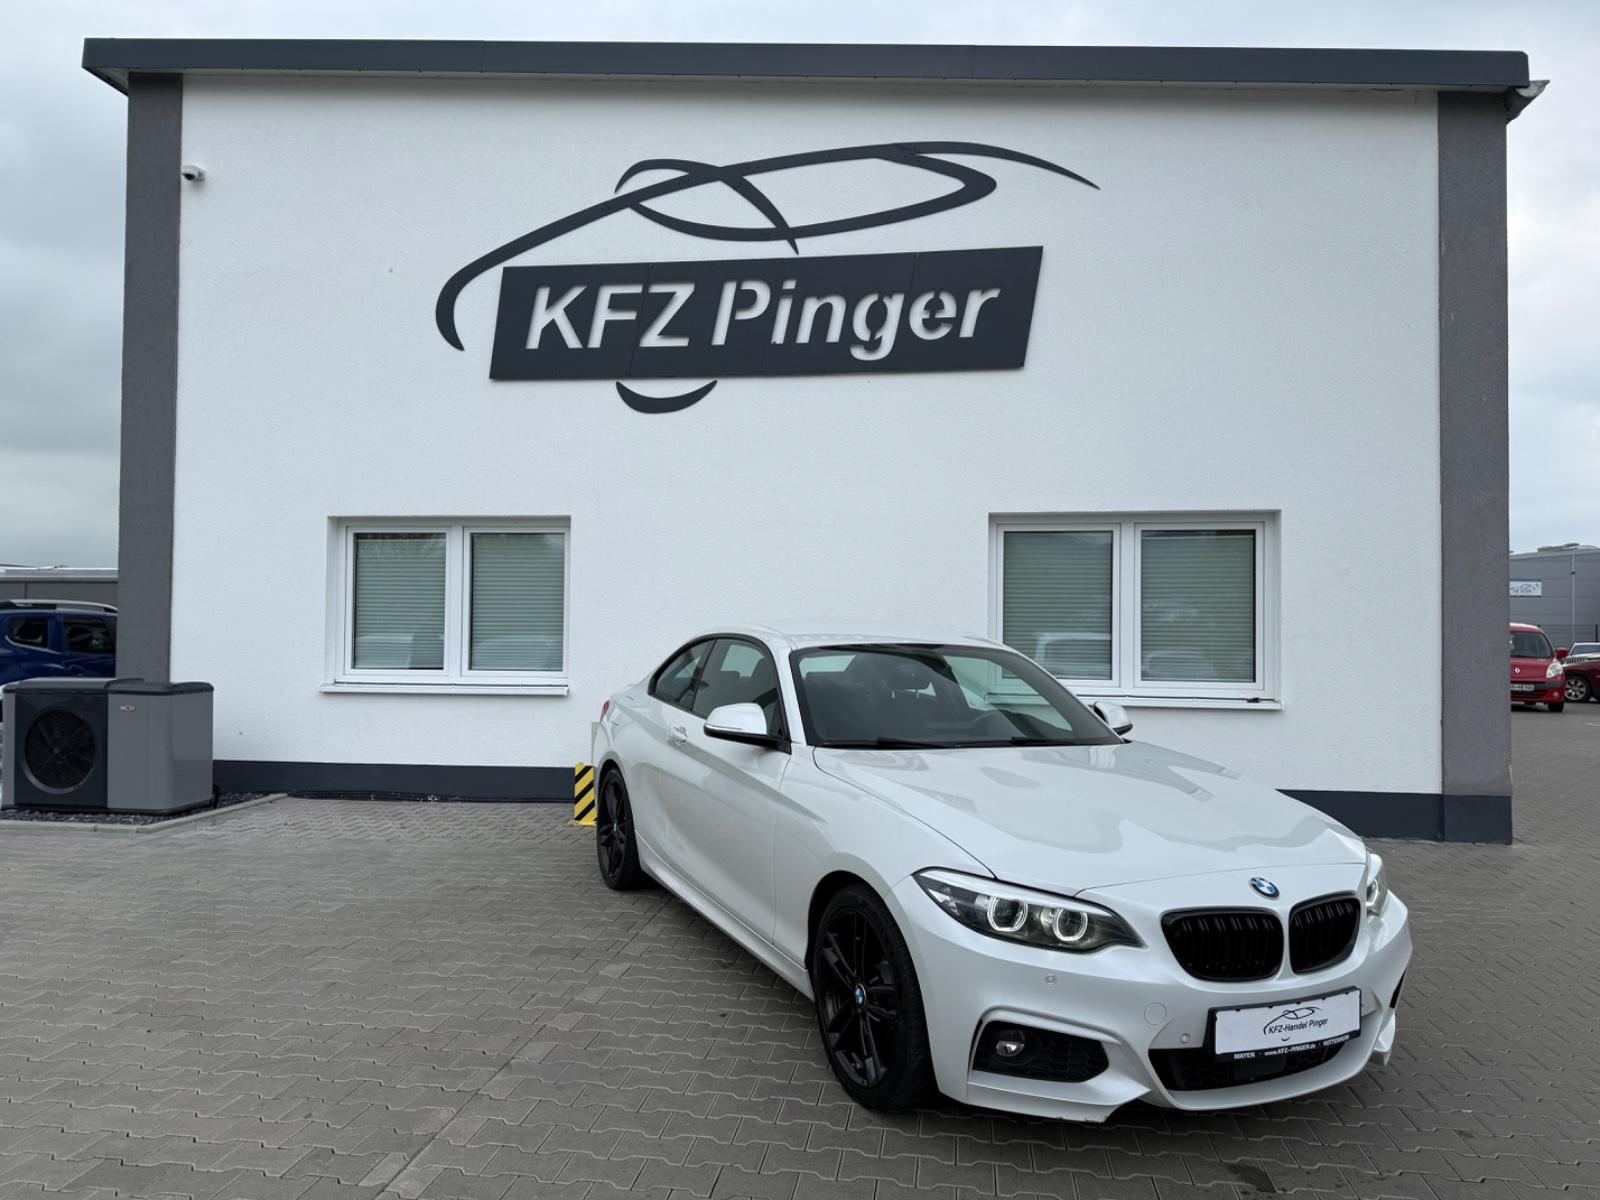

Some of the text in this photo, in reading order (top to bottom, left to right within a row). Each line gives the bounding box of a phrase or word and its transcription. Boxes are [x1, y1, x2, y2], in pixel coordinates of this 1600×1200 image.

[525, 279, 1001, 361] KFZ Pinger
[1268, 1018, 1328, 1034] KFZ-Handel Pinger
[1234, 1051, 1256, 1060] MAYEN
